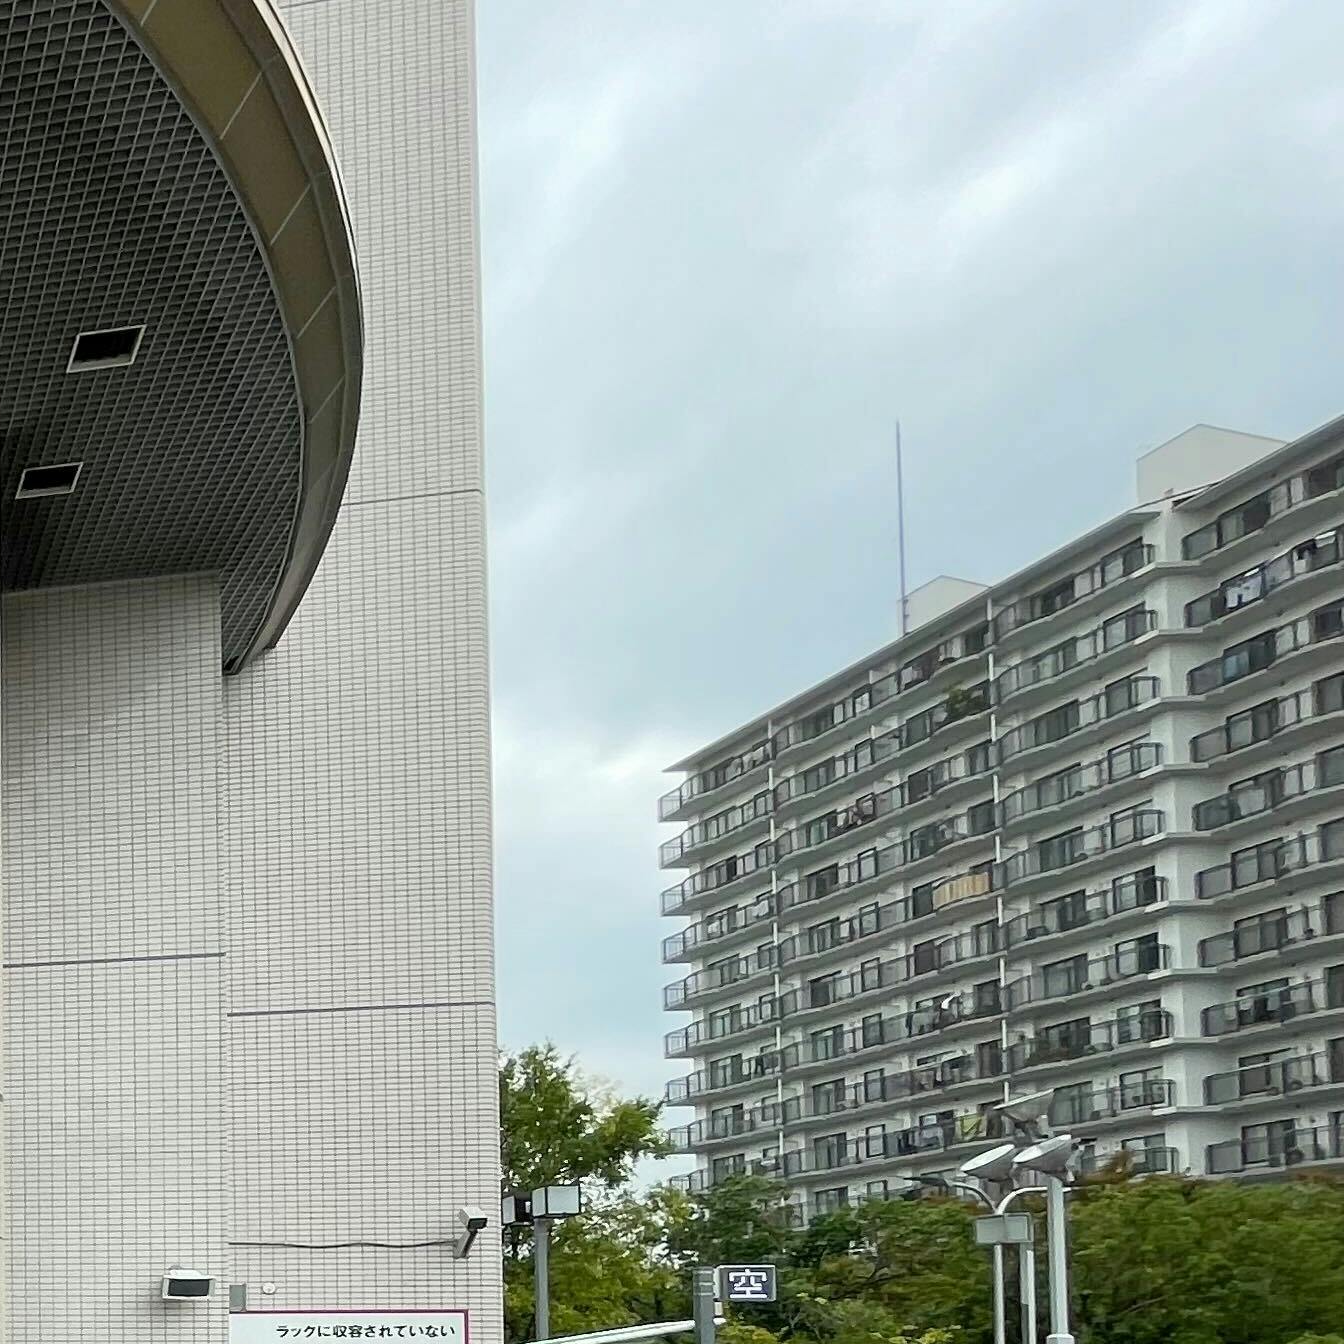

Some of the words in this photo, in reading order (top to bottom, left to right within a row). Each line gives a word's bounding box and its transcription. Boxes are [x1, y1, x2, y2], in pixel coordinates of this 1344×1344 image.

[729, 1268, 768, 1298] 空
[275, 1325, 455, 1339] ラックに収容されていない
